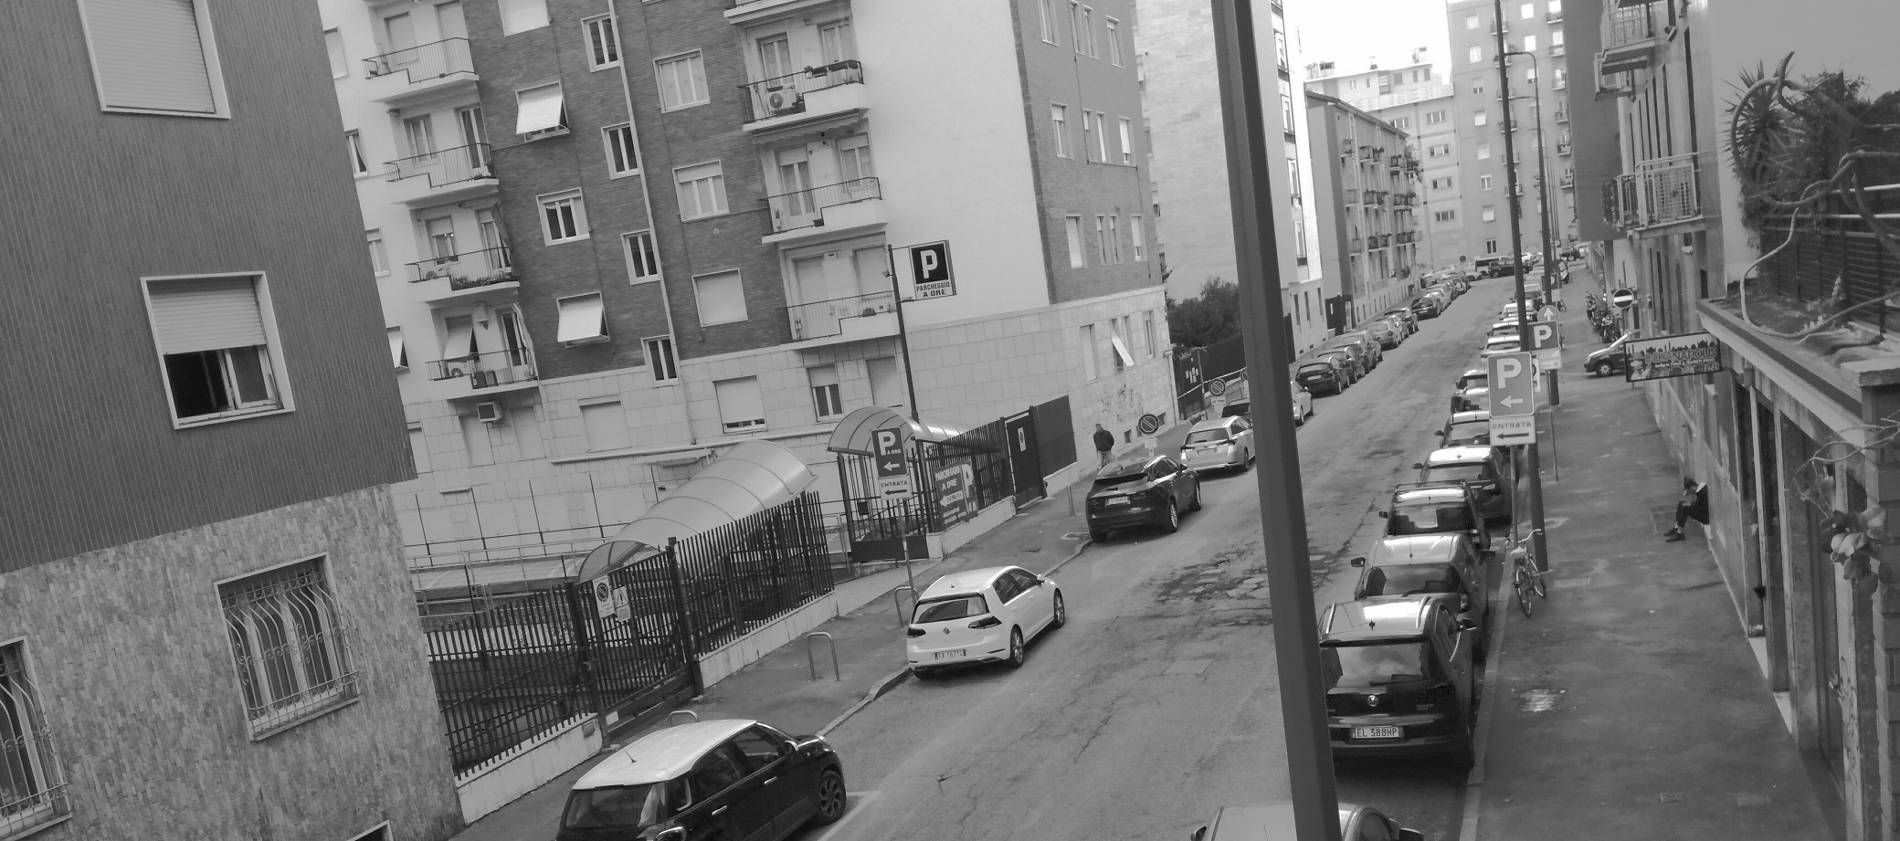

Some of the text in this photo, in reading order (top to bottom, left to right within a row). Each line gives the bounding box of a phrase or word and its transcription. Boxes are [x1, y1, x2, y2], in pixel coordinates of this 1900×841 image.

[920, 249, 938, 279] P
[916, 281, 950, 292] PARCHEGGIO
[930, 289, 945, 297] ORE
[1533, 325, 1552, 348] P
[1497, 357, 1522, 389] P
[1492, 421, 1532, 430] ENTRATA
[877, 431, 896, 456] P
[880, 480, 908, 488] ENTRATA
[962, 464, 974, 498] P
